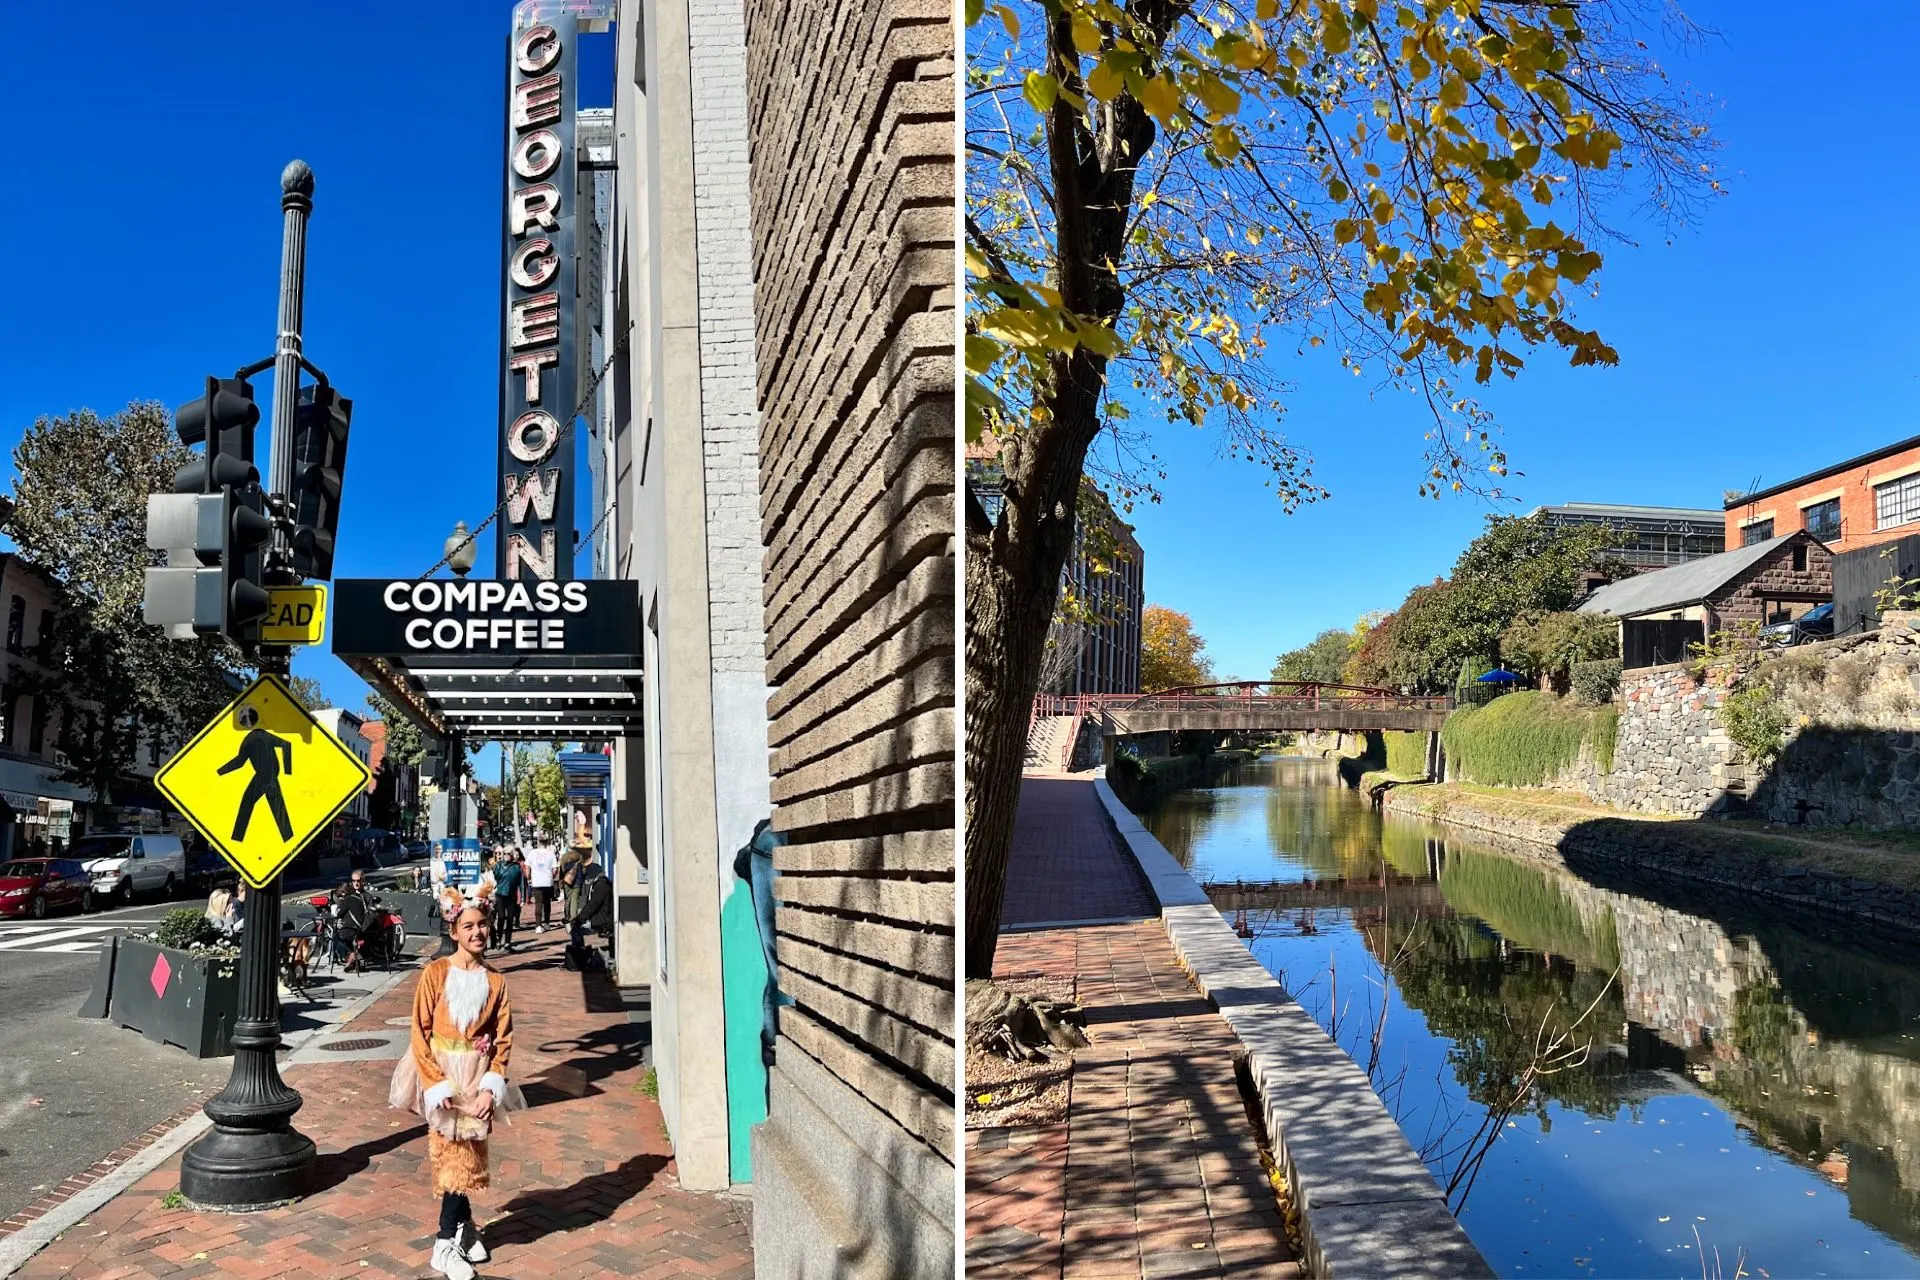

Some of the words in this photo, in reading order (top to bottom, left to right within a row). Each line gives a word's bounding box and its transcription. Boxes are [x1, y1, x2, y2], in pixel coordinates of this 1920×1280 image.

[503, 25, 562, 579] GEORGETOWN
[383, 581, 588, 612] COMPASS
[262, 603, 314, 626] EAD
[405, 618, 564, 649] COFFEE
[442, 851, 480, 862] GRAHAM
